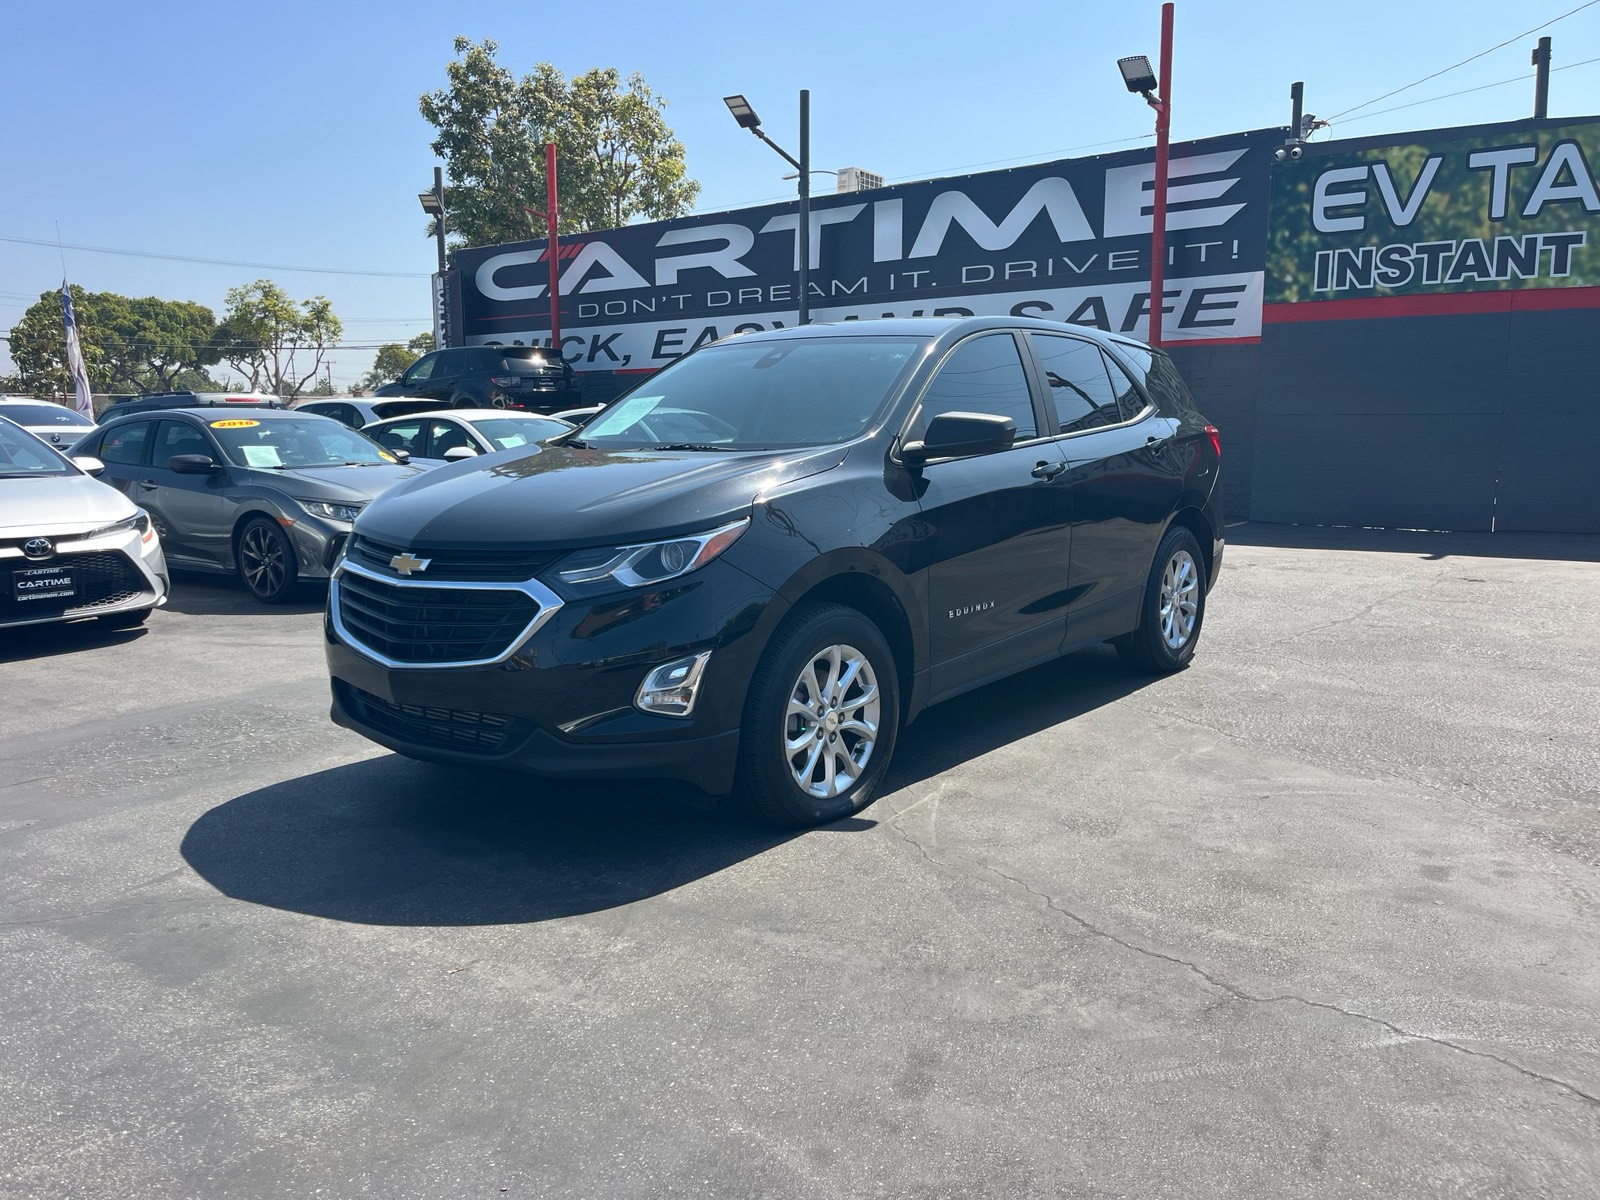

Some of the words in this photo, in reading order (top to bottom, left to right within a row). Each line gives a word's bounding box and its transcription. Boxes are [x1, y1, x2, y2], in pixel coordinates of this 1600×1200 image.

[475, 148, 1250, 301] CARTIME
[1311, 155, 1444, 234] EV
[578, 293, 692, 318] DON'T
[707, 276, 868, 307] DREAM
[890, 270, 937, 290] IT.
[961, 250, 1139, 284] DRIVE
[1168, 239, 1239, 265] IT!
[1314, 231, 1587, 292] INSTANT
[17, 577, 71, 588] CARTIME
